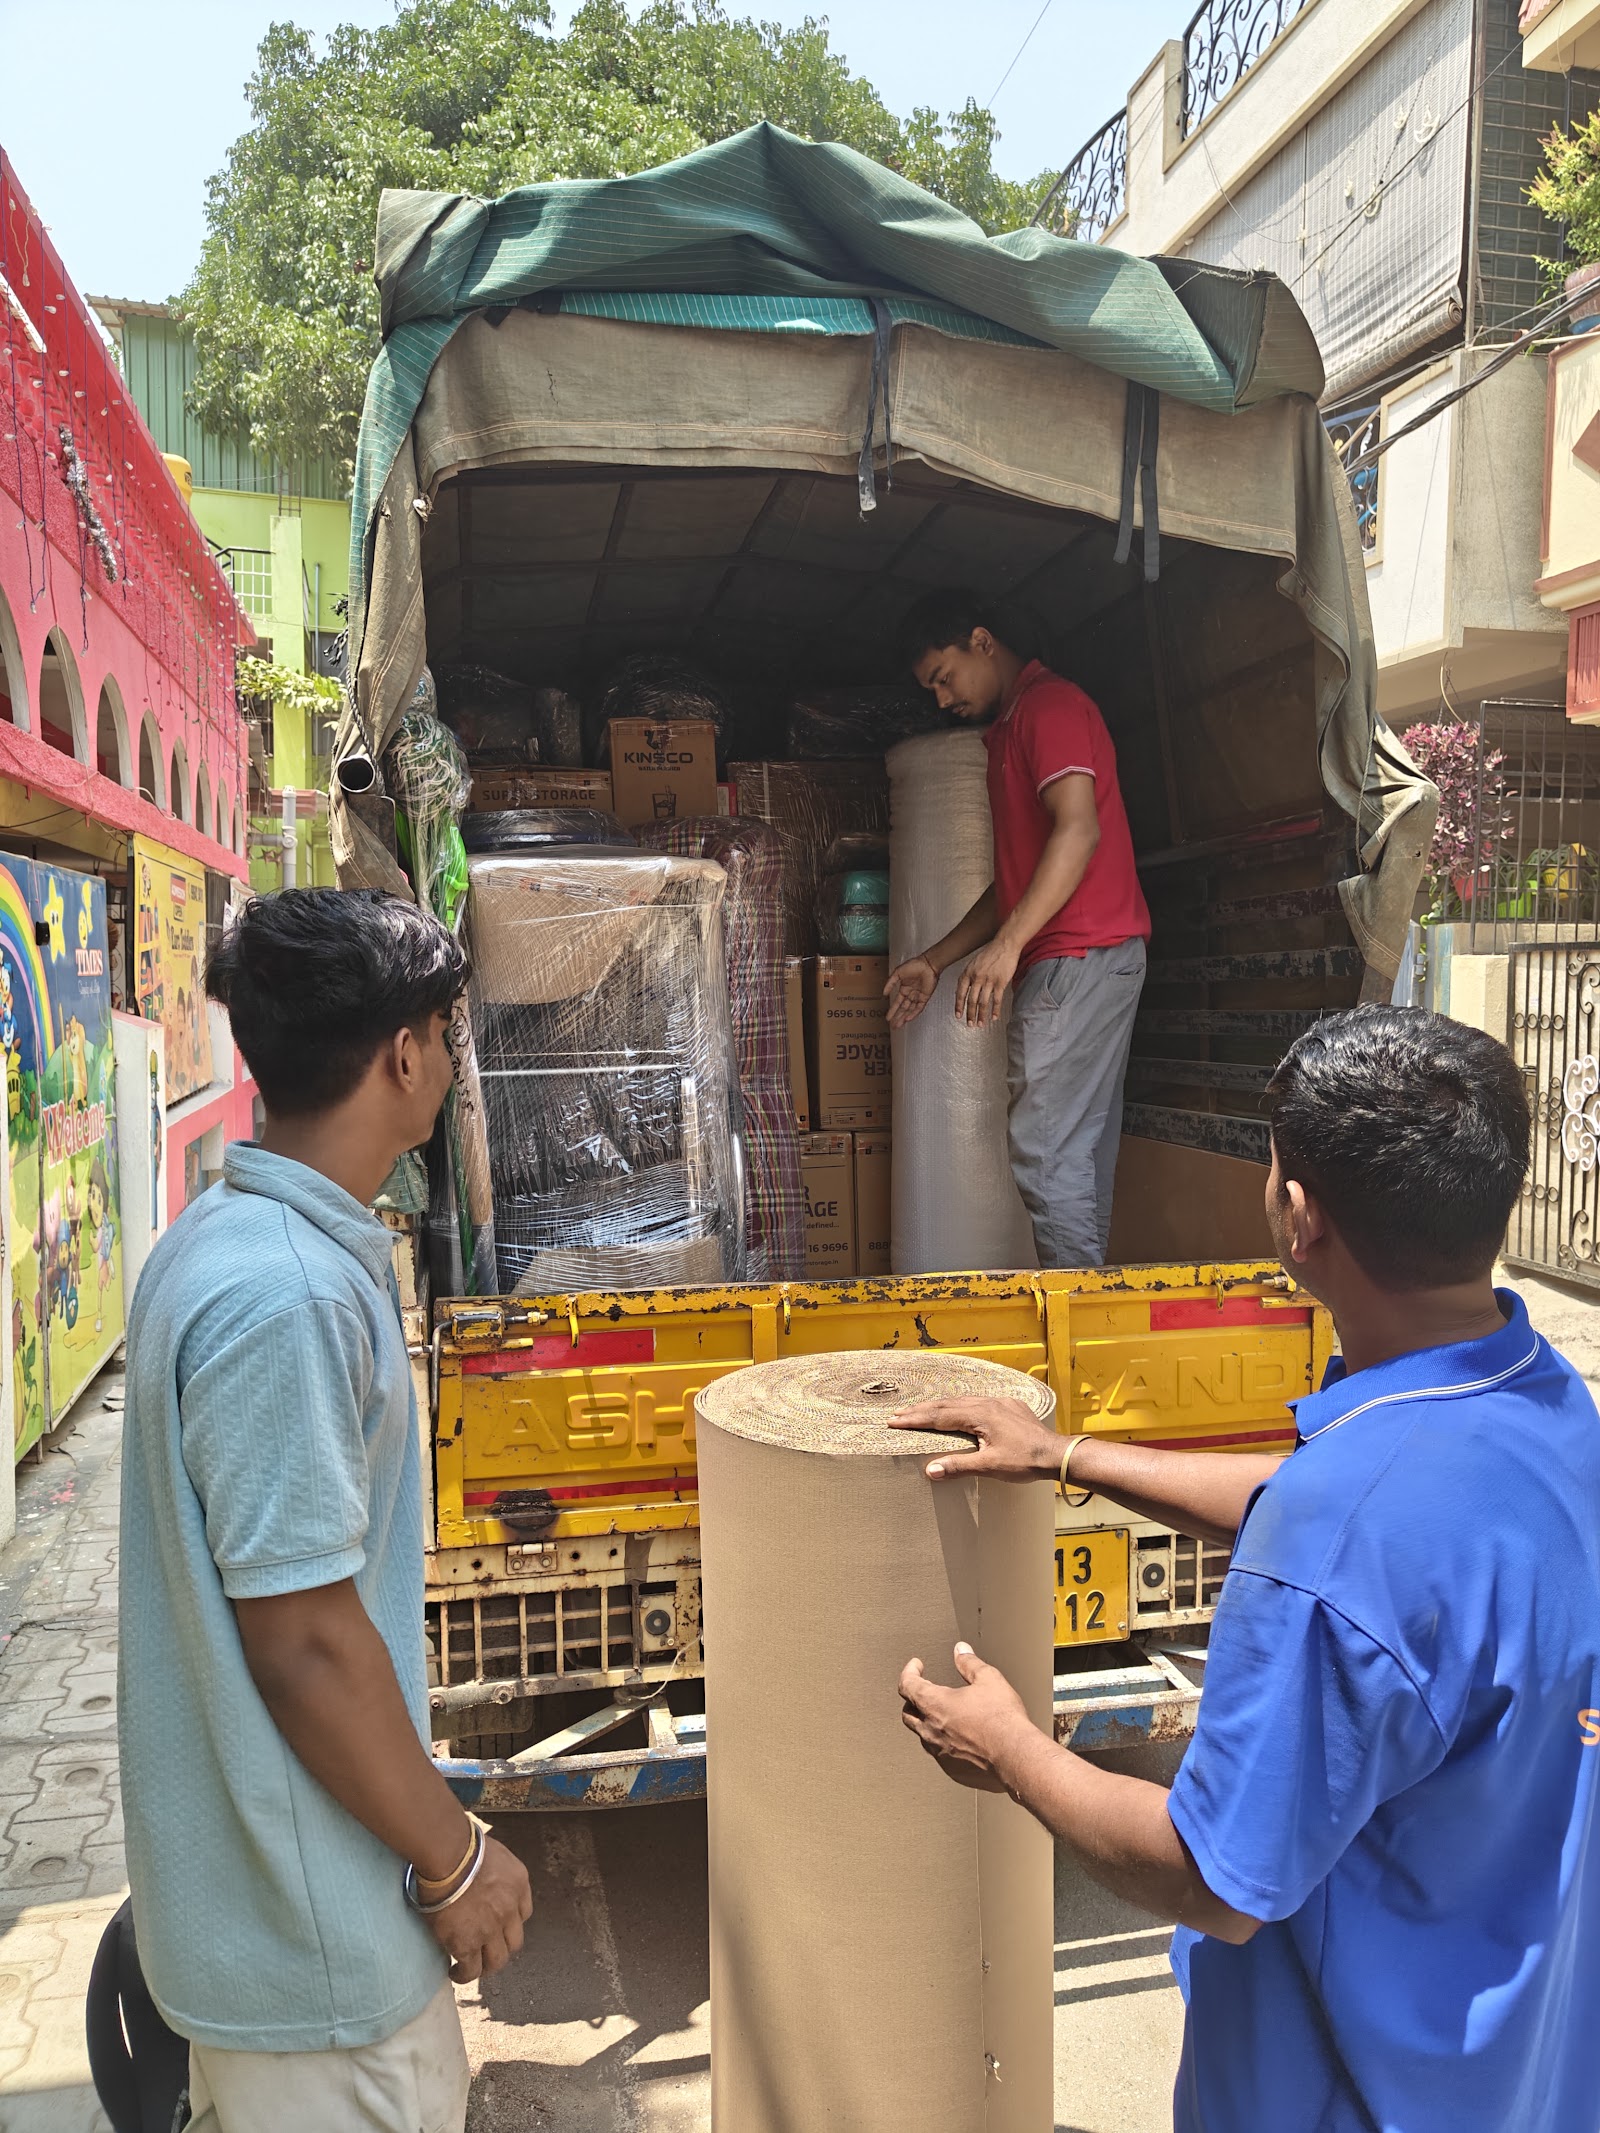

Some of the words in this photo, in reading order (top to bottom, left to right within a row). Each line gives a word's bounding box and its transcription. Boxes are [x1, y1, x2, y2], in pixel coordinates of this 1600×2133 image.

[624, 752, 694, 764] KINSCO
[75, 948, 104, 977] TIMES
[827, 1009, 853, 1018] 9696
[864, 1061, 891, 1076] ER
[43, 1094, 105, 1170] Welcome
[808, 1244, 820, 1253] 16
[822, 1243, 849, 1252] 9696
[1054, 1546, 1092, 1586] 13
[1054, 1590, 1105, 1632] 12
[1577, 1708, 1600, 1747] S
